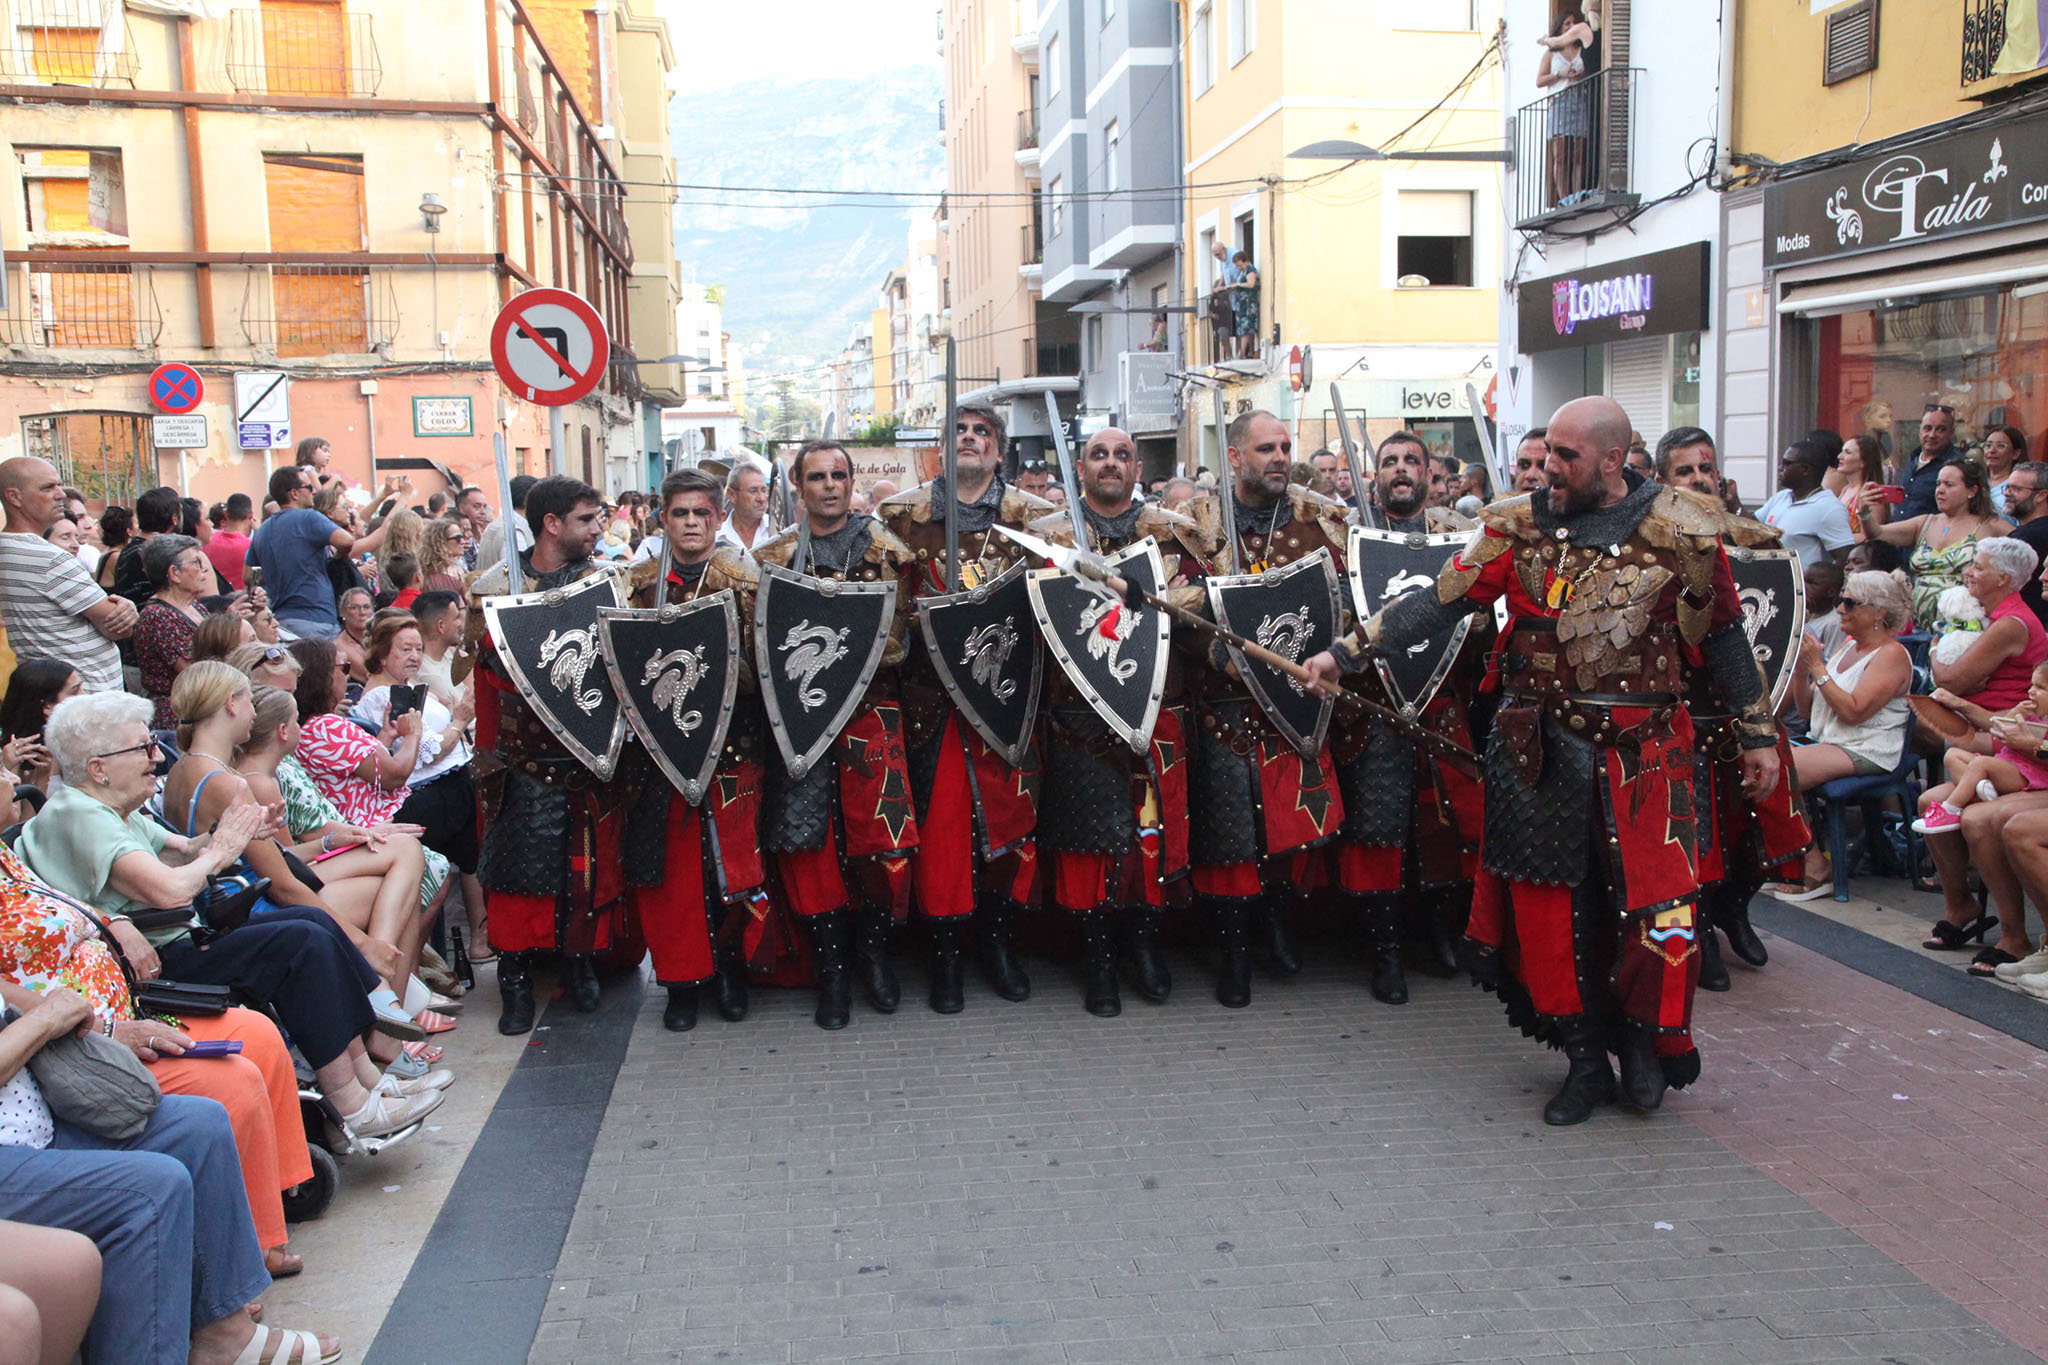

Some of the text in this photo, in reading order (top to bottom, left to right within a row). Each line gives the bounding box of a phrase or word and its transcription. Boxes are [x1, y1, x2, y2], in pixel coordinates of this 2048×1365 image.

[1862, 155, 1992, 242] Taila
[1776, 233, 1811, 253] Modas
[1568, 273, 1648, 321] LOISAN
[868, 464, 880, 474] de
[883, 463, 906, 477] Gala
